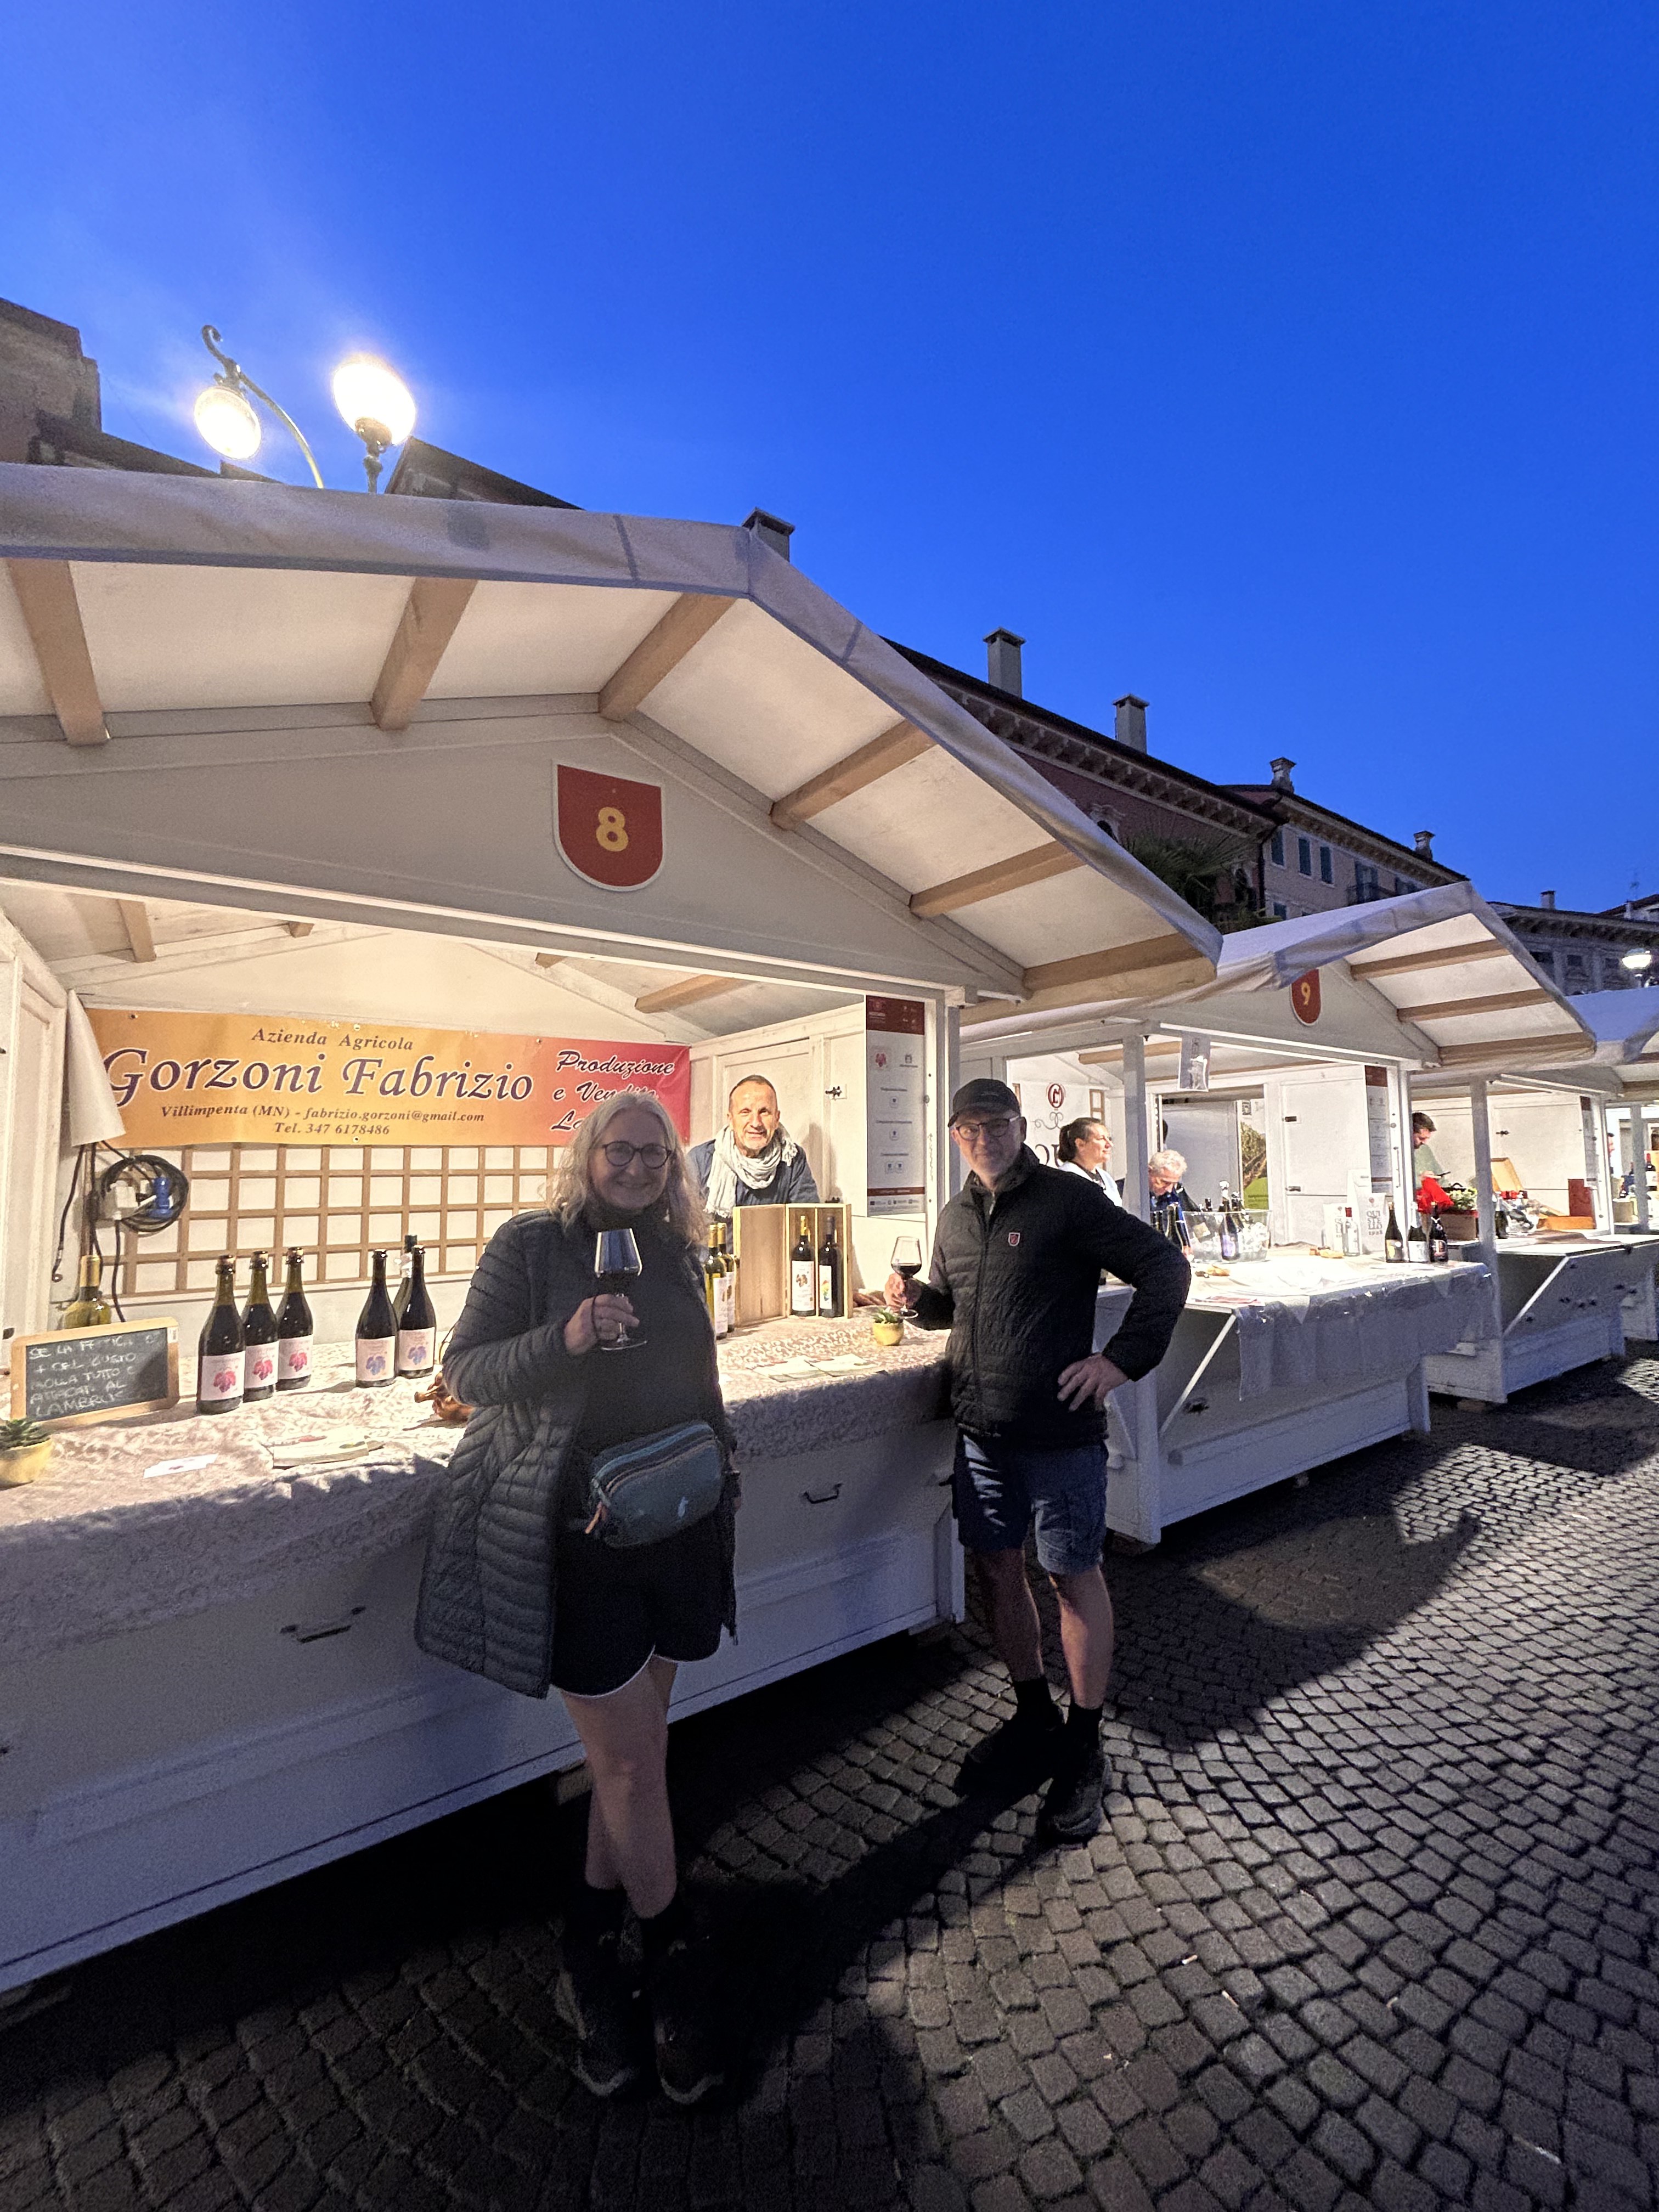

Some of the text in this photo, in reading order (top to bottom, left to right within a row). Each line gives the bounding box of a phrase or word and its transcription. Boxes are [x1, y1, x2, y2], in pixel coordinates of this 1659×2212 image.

[596, 806, 629, 851] 8
[1301, 982, 1311, 1005] 9
[251, 1028, 414, 1051] Azienda Agricola
[556, 1050, 675, 1079] Produzione
[103, 1048, 534, 1108] Gorzoni Fabrizio
[553, 1081, 657, 1102] e Vent
[161, 1105, 248, 1118] Villimpenta
[252, 1105, 290, 1119] (MN)
[303, 1107, 485, 1123] fabrizio.gorzoni@gmail.com
[275, 1122, 390, 1135] Tel. 347 6178486
